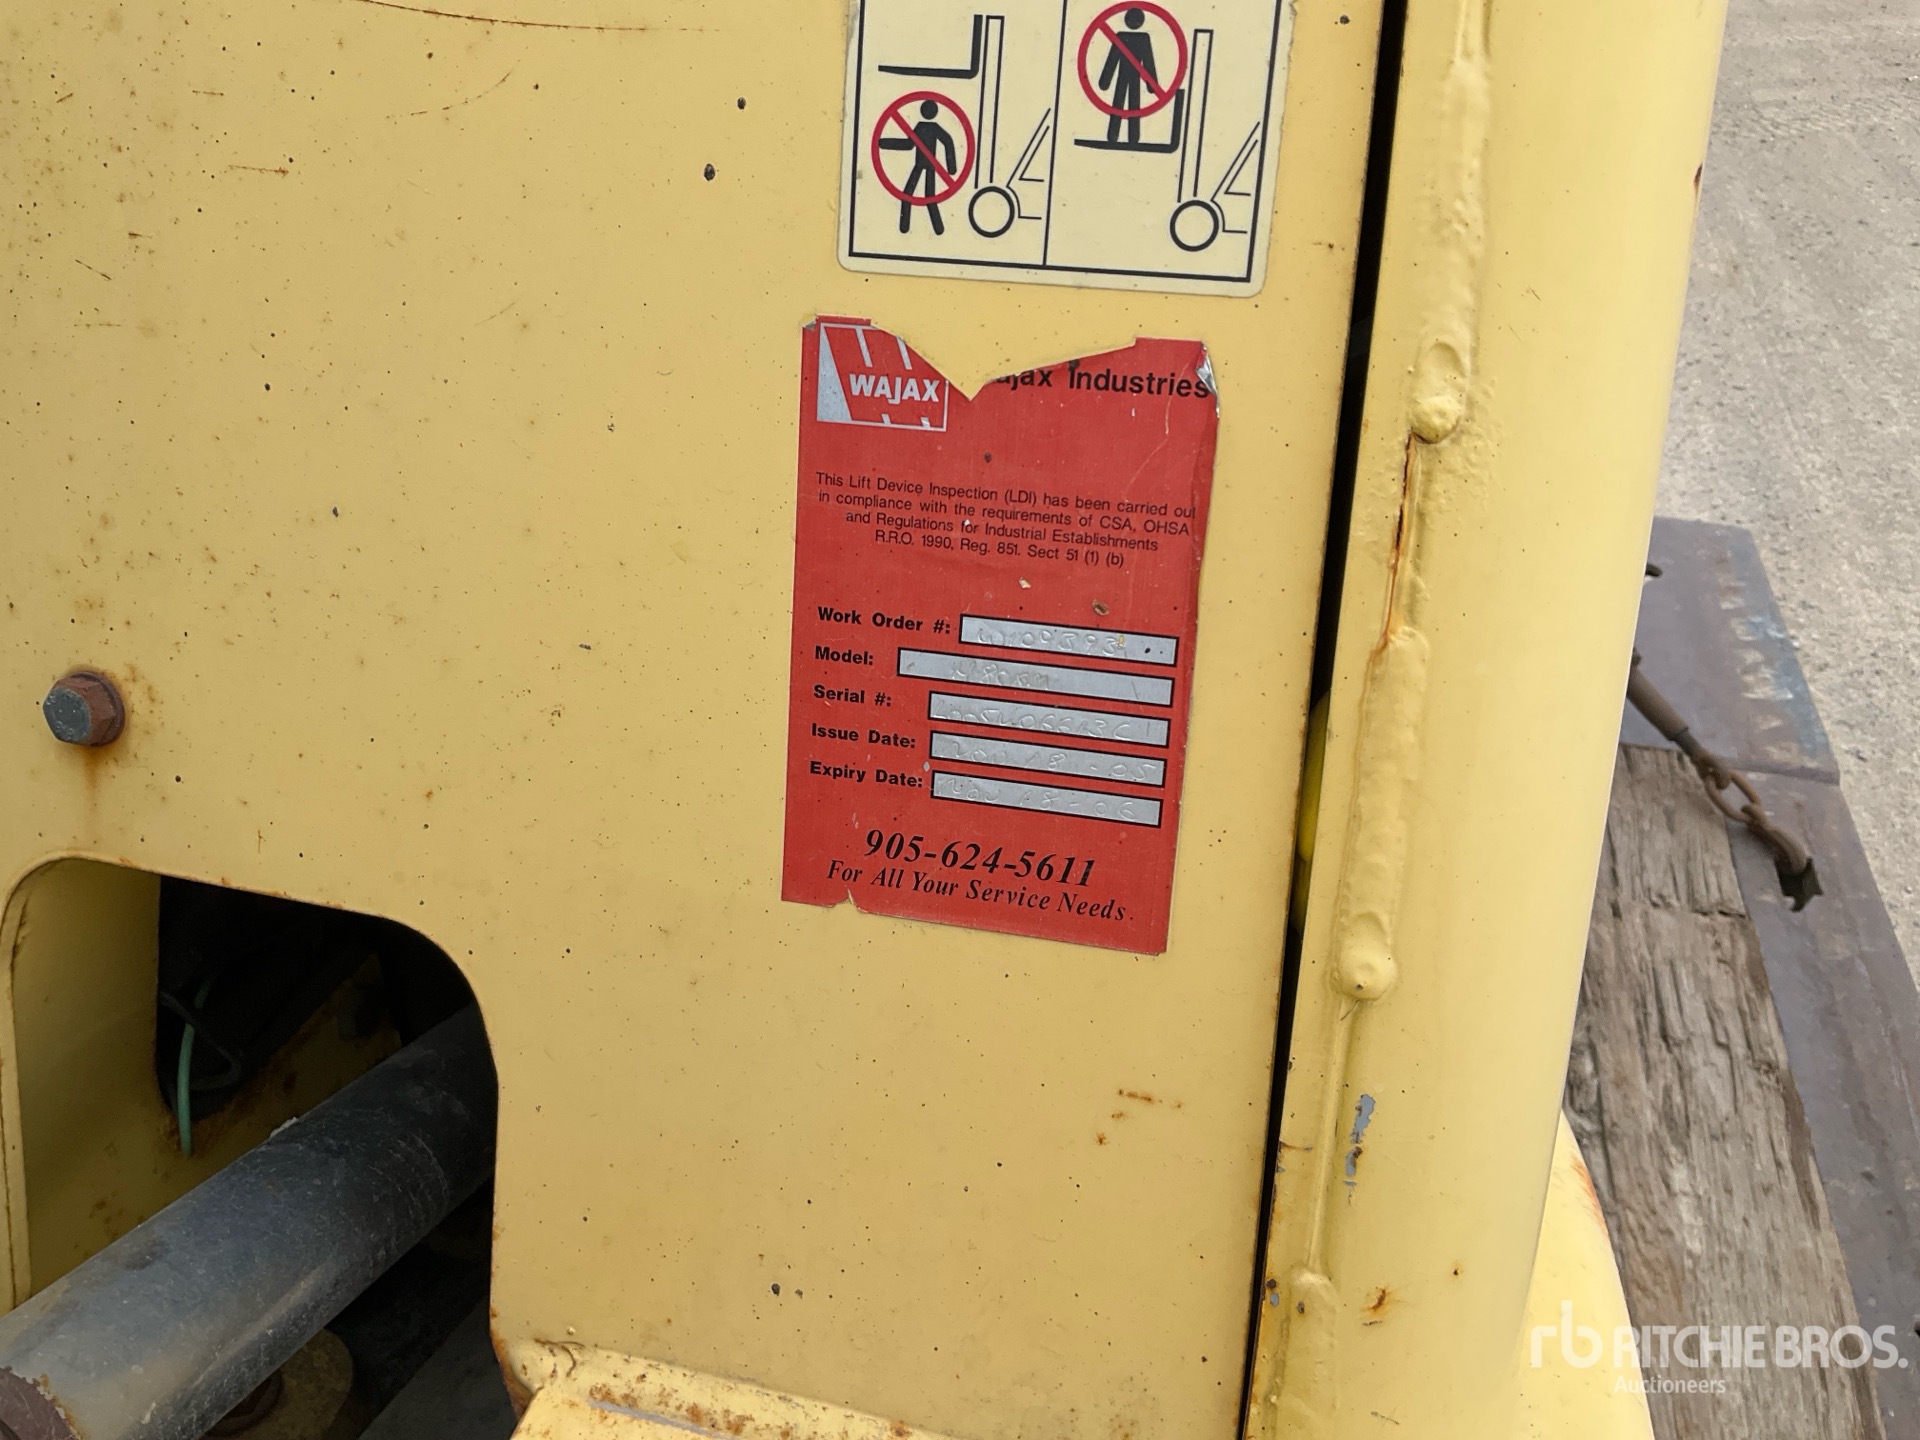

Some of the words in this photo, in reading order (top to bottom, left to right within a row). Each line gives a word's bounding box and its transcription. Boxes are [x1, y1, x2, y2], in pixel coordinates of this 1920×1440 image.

[849, 373, 939, 405] WAJAX
[1068, 362, 1210, 399] Industries
[816, 472, 844, 487] This
[849, 475, 871, 490] Lift
[877, 477, 924, 494] Device
[929, 483, 998, 500] Inspection
[1004, 489, 1037, 506] (LDI)
[1043, 493, 1069, 508] has
[1075, 496, 1110, 511] been
[1117, 501, 1168, 516] carried
[818, 489, 830, 502] in
[836, 493, 913, 511] compliance
[919, 501, 948, 515] with
[954, 503, 976, 517] the
[982, 507, 1072, 526] requirements
[1078, 514, 1092, 528] of
[1100, 515, 1137, 533] CSA,
[1143, 519, 1190, 536] OHSA
[846, 511, 871, 524] and
[876, 512, 954, 532] Regulations
[961, 520, 979, 534] for
[985, 523, 1046, 541] Industrial
[1052, 528, 1159, 551] Establishments
[875, 529, 914, 546] R.R.O.
[960, 538, 990, 556] Reg.
[1027, 544, 1059, 560] Sect
[1066, 549, 1079, 562] 51
[1084, 550, 1099, 566] (1)
[1105, 552, 1124, 569] (b)
[817, 606, 862, 625] Work
[872, 612, 923, 632] Order
[933, 619, 951, 634] #:
[815, 645, 874, 666] Model:
[813, 684, 865, 704] Serial
[874, 692, 891, 707] #:
[811, 723, 859, 742] Issue
[868, 729, 915, 749] Date:
[810, 760, 866, 783] Expiry
[875, 769, 923, 788] Date:
[863, 829, 1096, 888] 905-624-5611
[826, 859, 863, 883] For
[870, 866, 903, 889] All
[911, 871, 959, 897] Your
[965, 878, 1051, 910] Service
